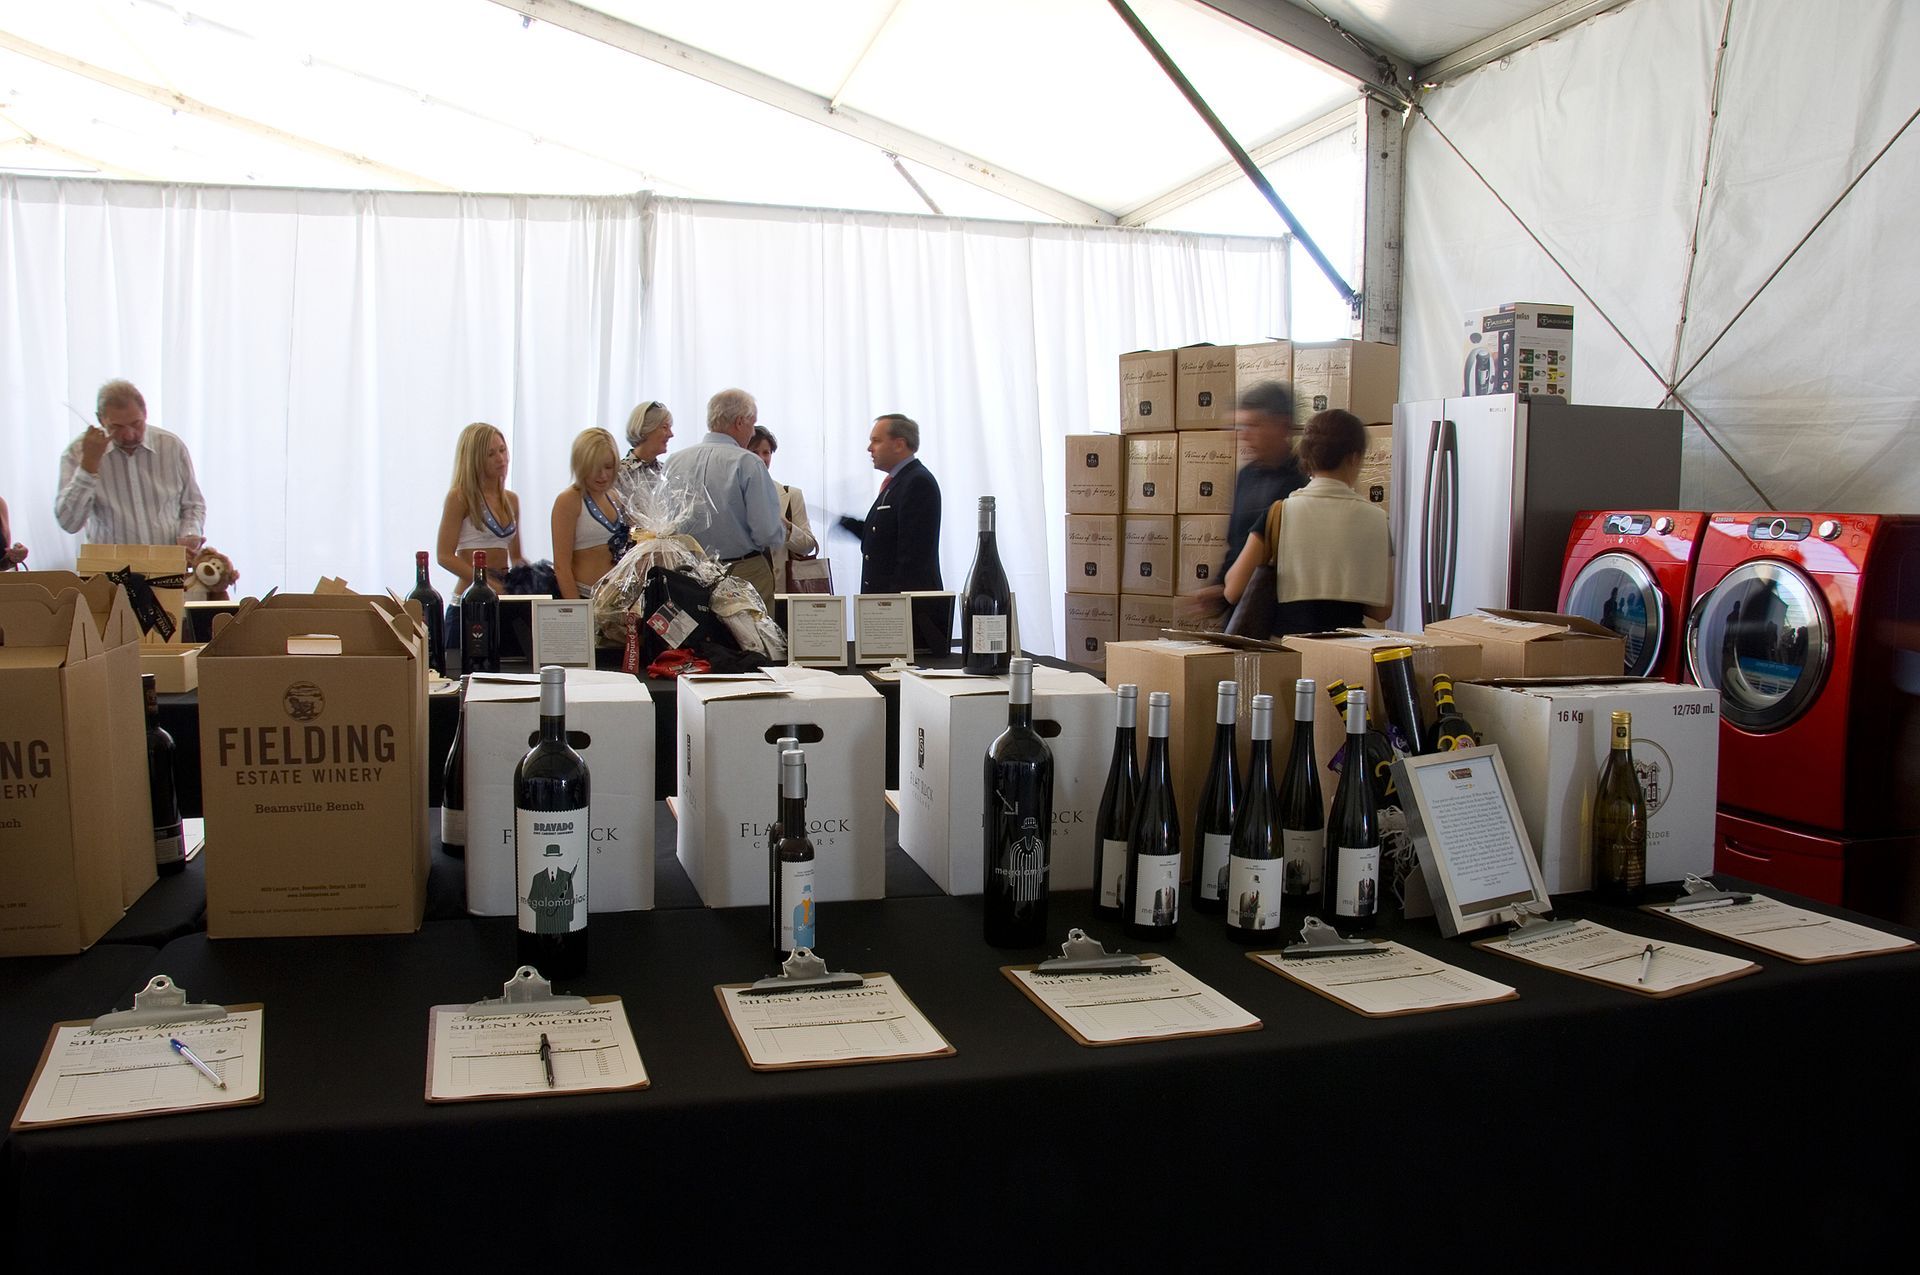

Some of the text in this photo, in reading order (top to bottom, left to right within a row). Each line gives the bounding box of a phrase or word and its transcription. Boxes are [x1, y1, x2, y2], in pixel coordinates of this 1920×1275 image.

[1557, 710, 1584, 724] 16 Kg
[1672, 703, 1715, 716] 12/750 mL
[218, 724, 396, 766] FIELDING
[236, 767, 383, 785] ESTATE WINERY
[255, 801, 365, 814] Beamsville Bench
[533, 822, 574, 832] BRAVADO
[740, 822, 773, 838] FLA
[520, 892, 586, 908] megalomaniac
[1034, 976, 1093, 985] SILENT
[738, 996, 804, 1006] SILENT
[808, 989, 888, 1001] AUCTION
[450, 1016, 613, 1031] SILENT AUCTION
[69, 1024, 248, 1047] SILENT AUCTION
